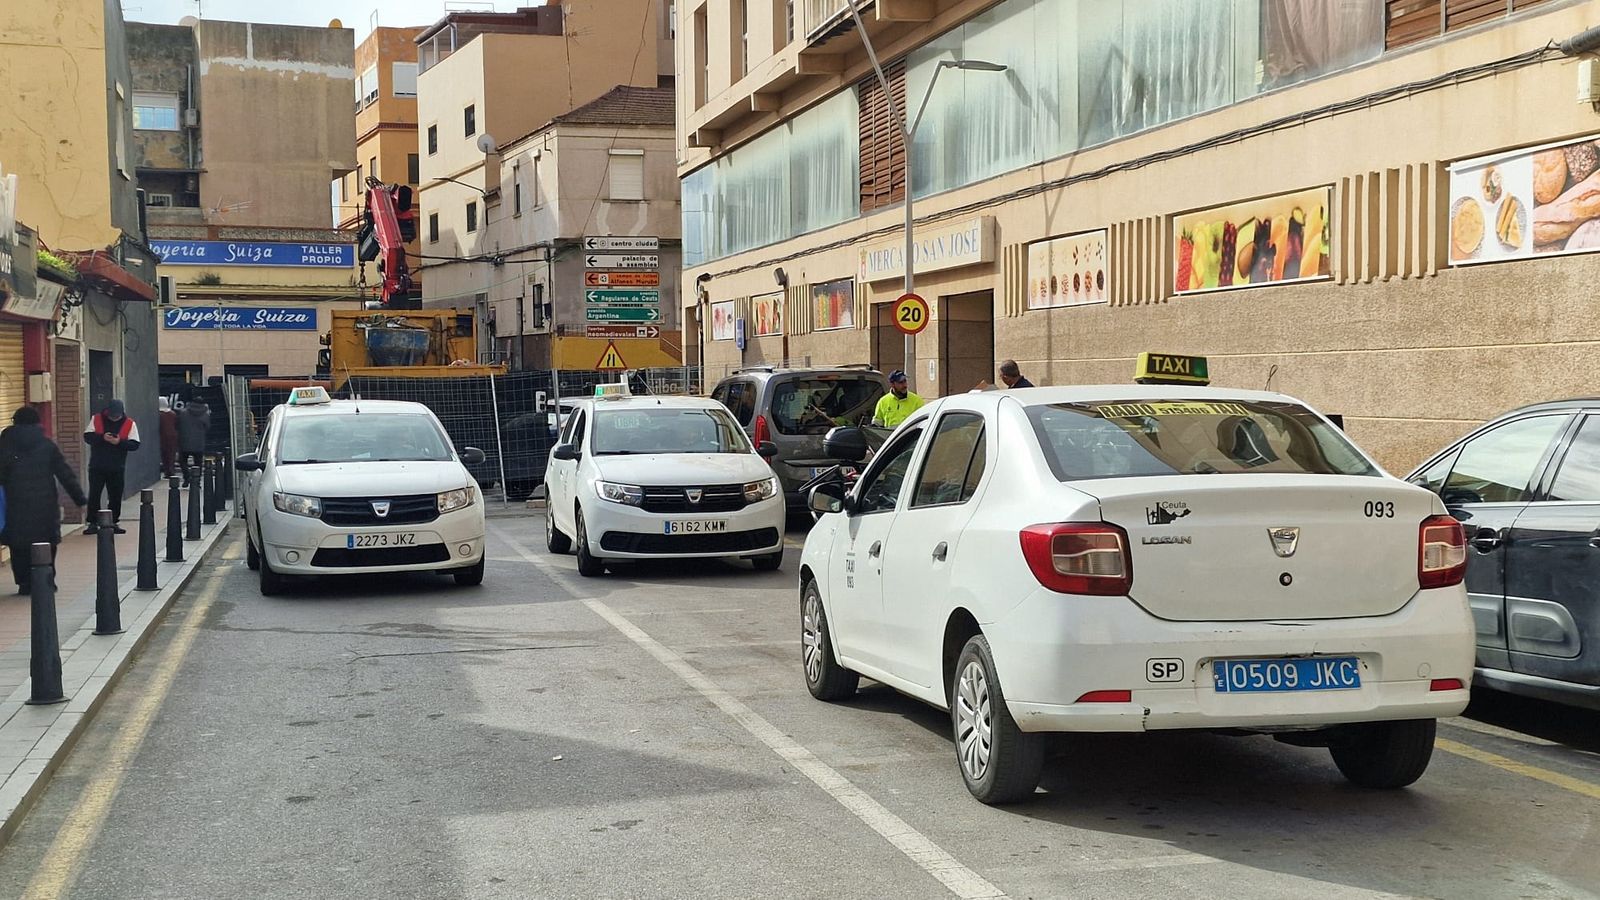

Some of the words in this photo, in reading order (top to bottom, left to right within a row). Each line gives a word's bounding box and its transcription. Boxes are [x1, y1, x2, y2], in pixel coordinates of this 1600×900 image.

[149, 243, 206, 261] oyeria
[224, 243, 273, 262] Suiza
[301, 245, 343, 255] TALLER
[868, 243, 920, 273] MERCAO
[923, 236, 946, 264] SAN
[949, 220, 979, 257] JOSÉ
[301, 255, 343, 264] PROPIO
[166, 308, 241, 327] Joyería
[253, 308, 309, 324] Suiza
[900, 306, 922, 322] 20
[1151, 356, 1190, 374] TAXI
[297, 390, 315, 398] TAXI
[1098, 403, 1157, 418] RADIO
[1158, 407, 1209, 415] 515406
[1205, 403, 1250, 416] TAXI
[1161, 501, 1187, 509] Ceuta
[1363, 500, 1395, 518] 093
[671, 521, 700, 533] 6162
[704, 520, 726, 532] KMW
[356, 534, 388, 547] 2273
[392, 533, 416, 545] JKZ
[1141, 535, 1192, 545] LOGAN
[846, 559, 855, 573] TAXI
[1151, 662, 1179, 678] SP
[1231, 663, 1299, 689] 0509
[1309, 660, 1355, 687] JKC
